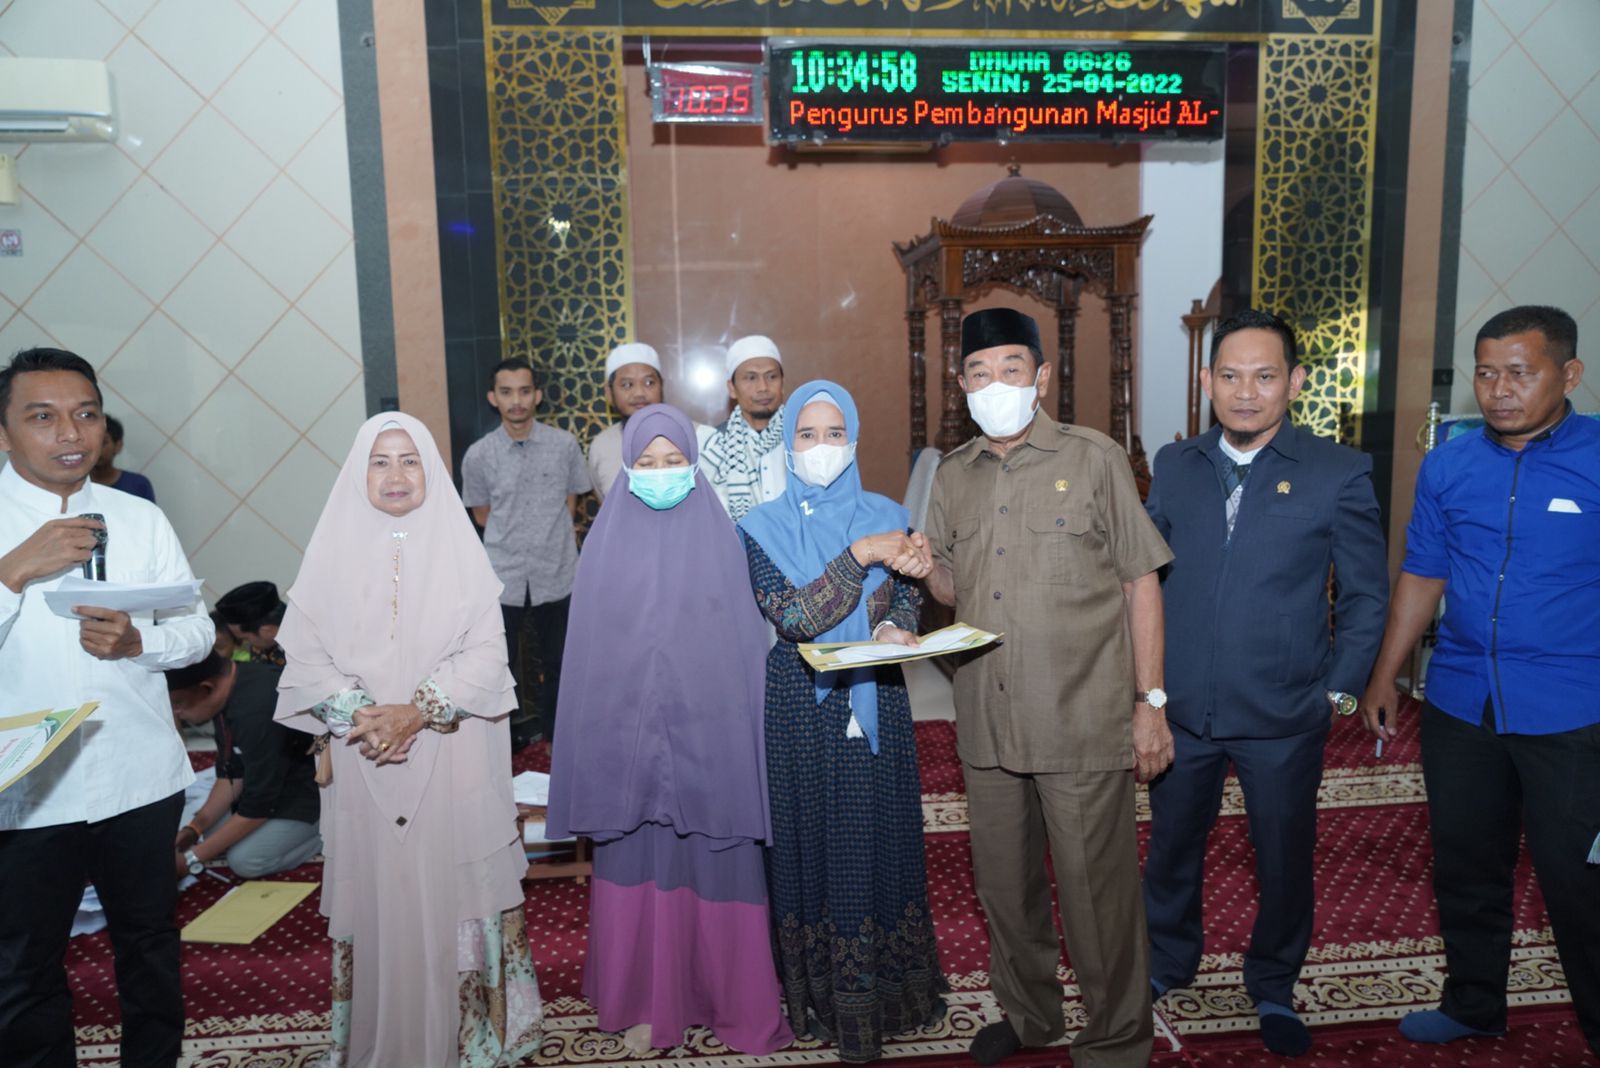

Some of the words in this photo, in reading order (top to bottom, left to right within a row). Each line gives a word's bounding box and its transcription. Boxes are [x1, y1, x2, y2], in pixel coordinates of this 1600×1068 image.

[791, 51, 917, 93] 10:34:58
[1063, 51, 1132, 72] 06:26
[1043, 73, 1182, 94] 25-04-2022
[790, 100, 908, 132] Pengurus
[915, 100, 1088, 132] Pembangunan
[1097, 100, 1171, 132] Masjid
[1176, 100, 1219, 125] AL-
